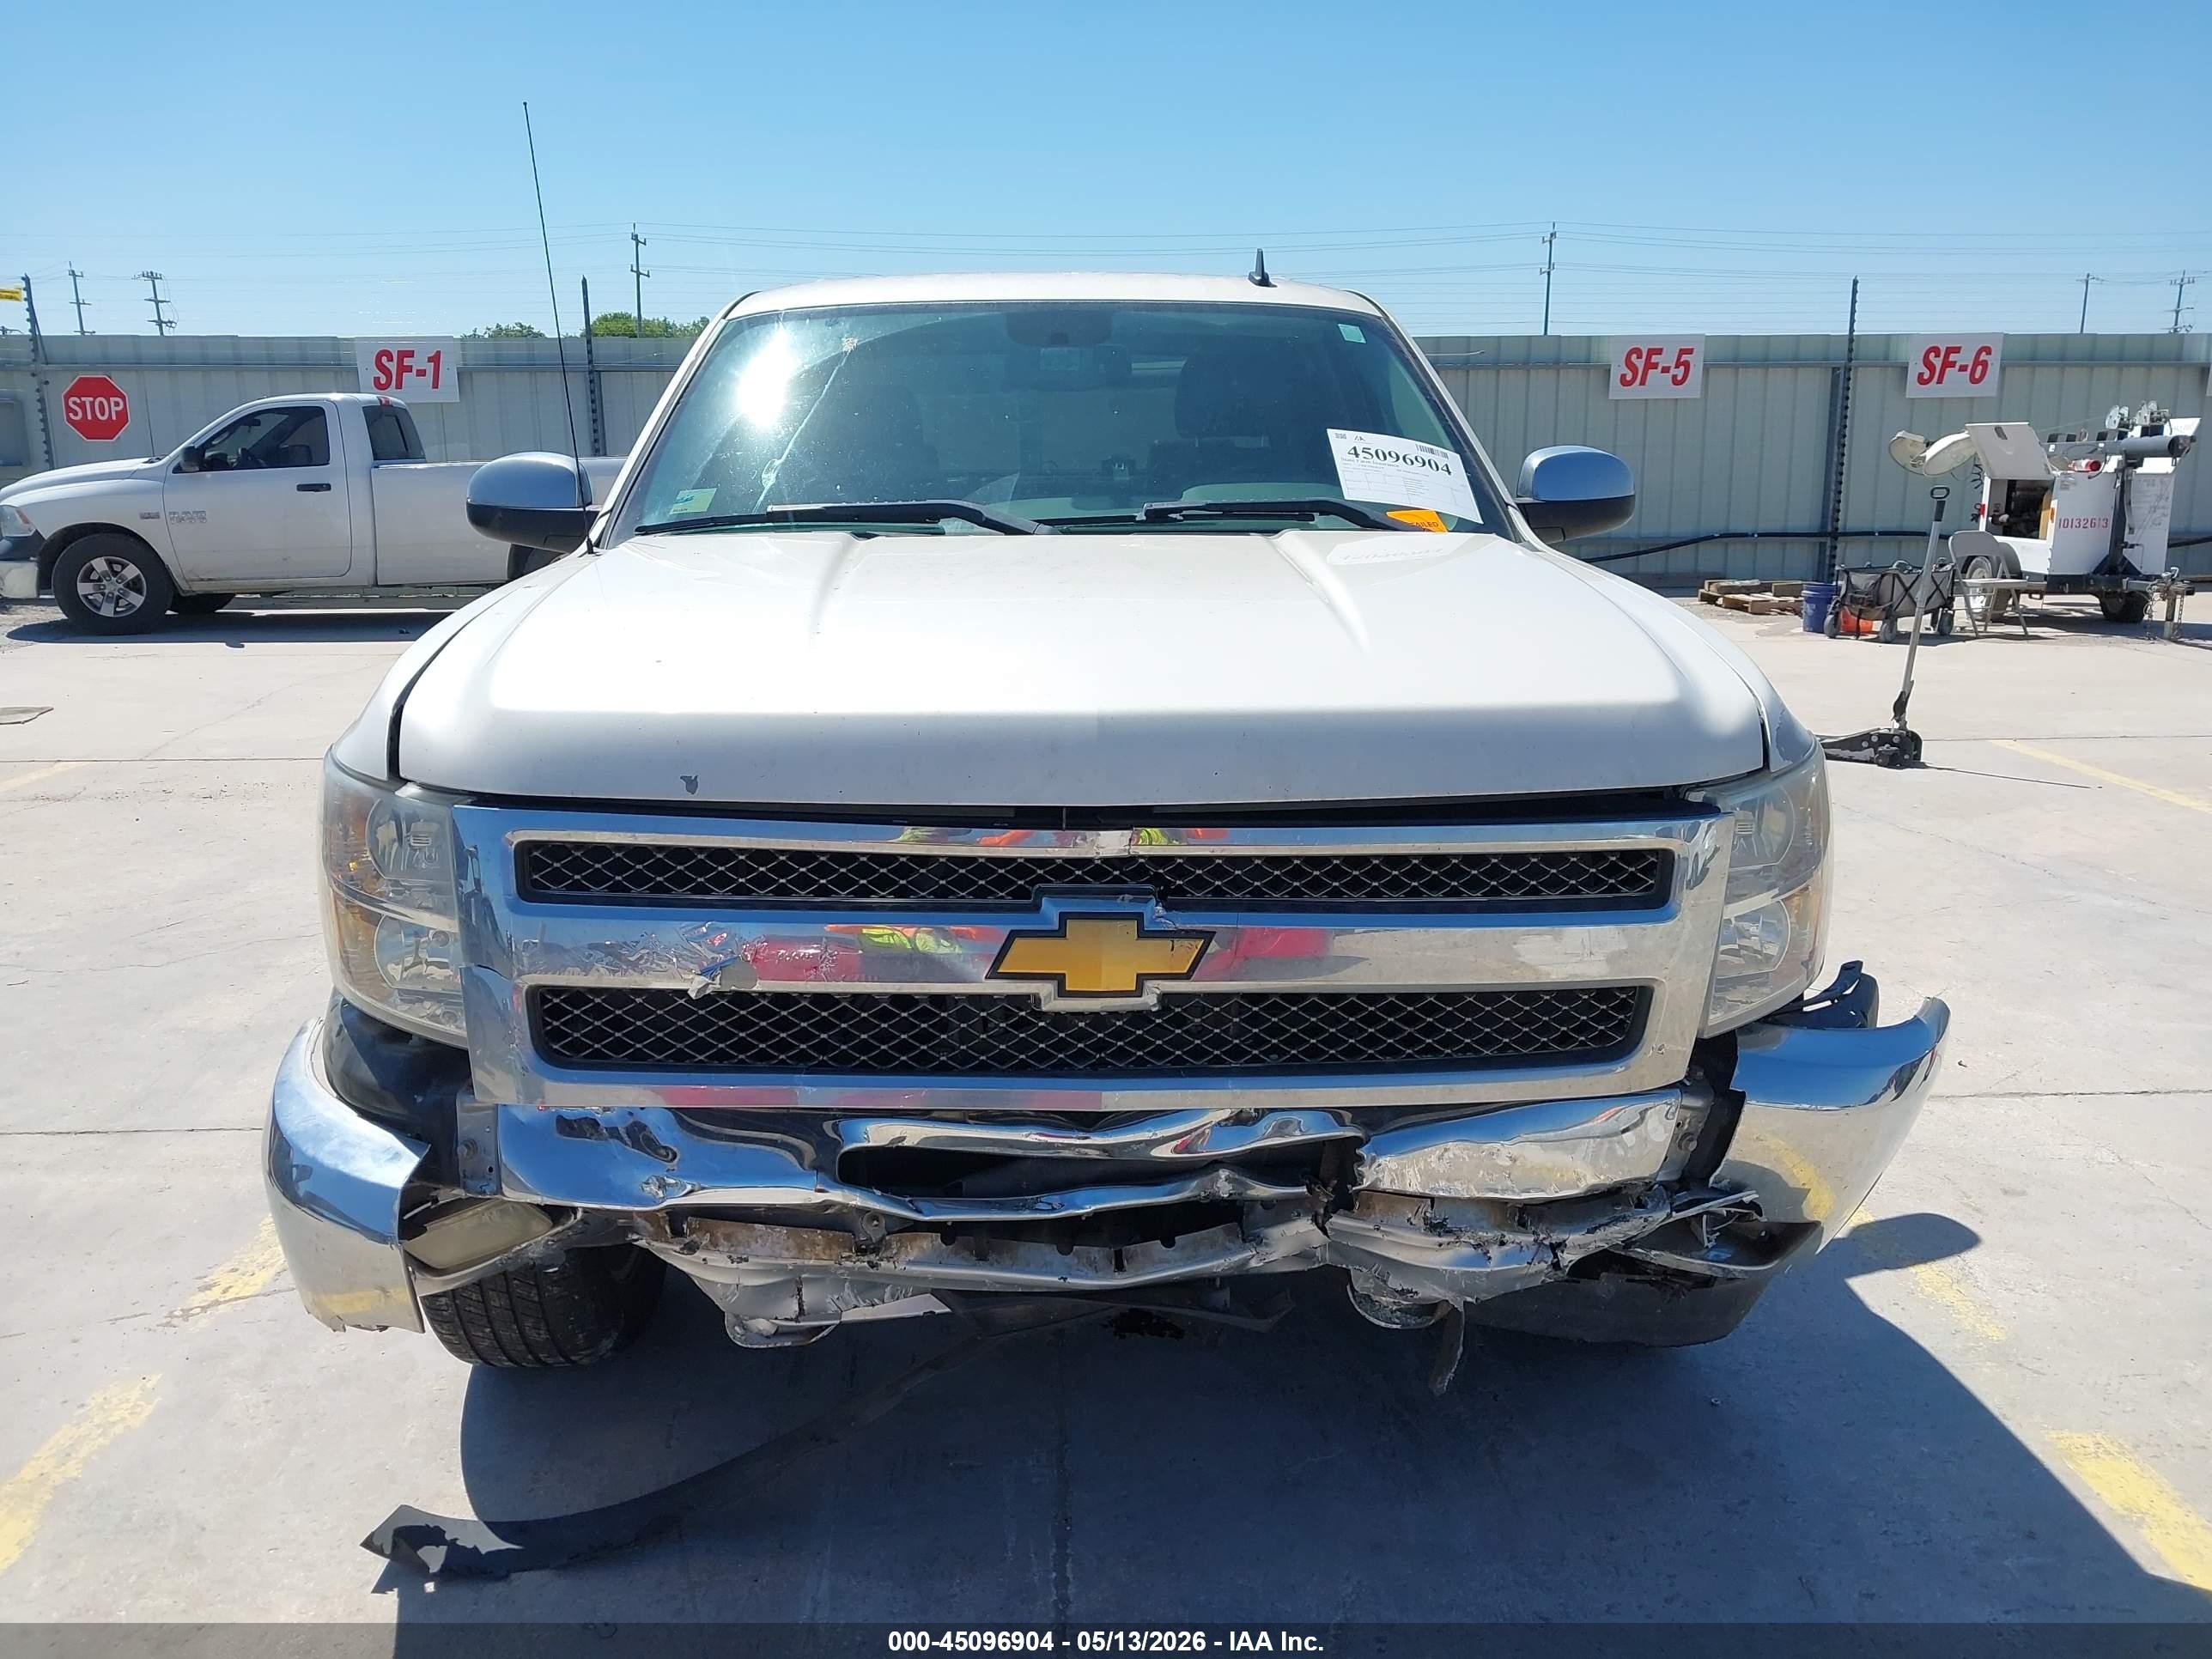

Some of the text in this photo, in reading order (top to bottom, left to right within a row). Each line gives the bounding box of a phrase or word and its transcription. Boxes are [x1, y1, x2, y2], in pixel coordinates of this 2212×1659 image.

[374, 349, 441, 391] SF-1
[1620, 347, 1694, 387] SF-5
[1917, 345, 1992, 386] SF-6
[68, 397, 124, 421] STOP
[1347, 446, 1452, 476] 45096904
